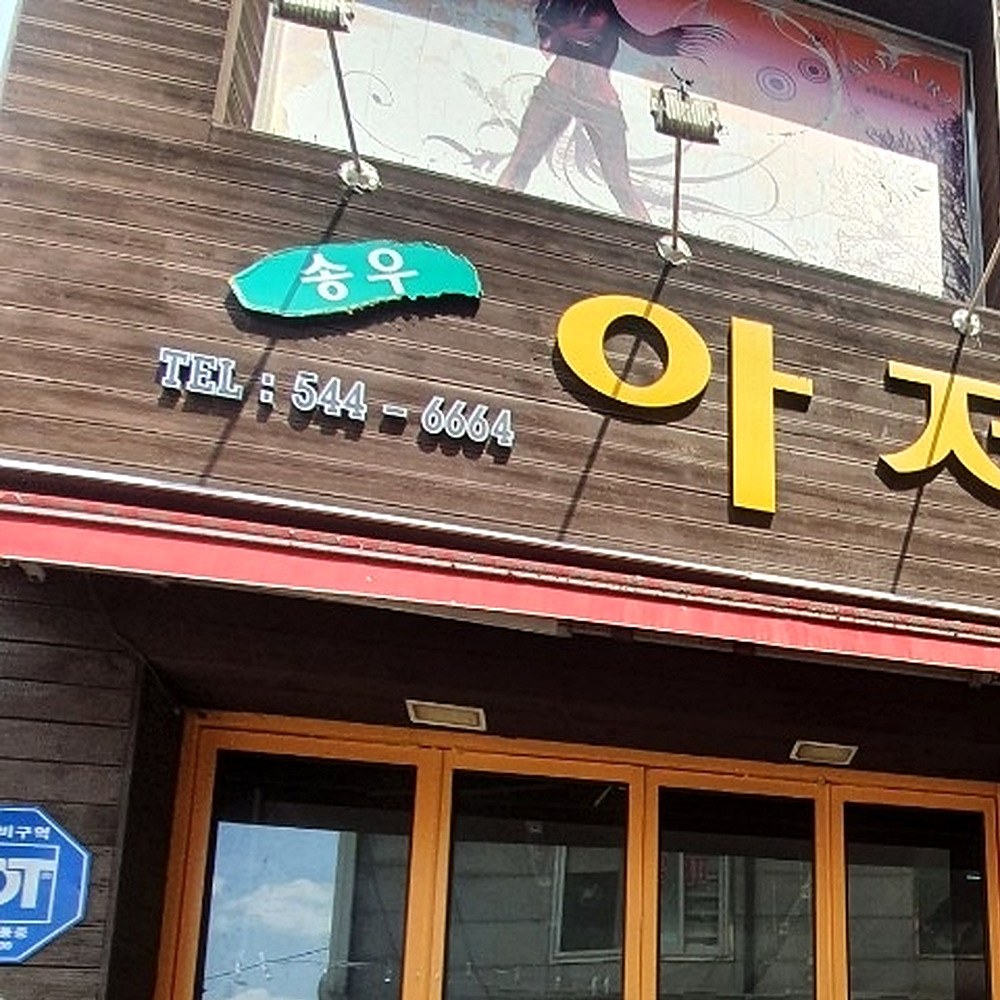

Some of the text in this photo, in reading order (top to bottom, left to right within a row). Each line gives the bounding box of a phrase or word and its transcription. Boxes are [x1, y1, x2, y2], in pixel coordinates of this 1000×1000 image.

[301, 246, 419, 301] 송우
[158, 346, 243, 400] TEL
[291, 371, 367, 422] 544
[421, 397, 515, 448] 6664
